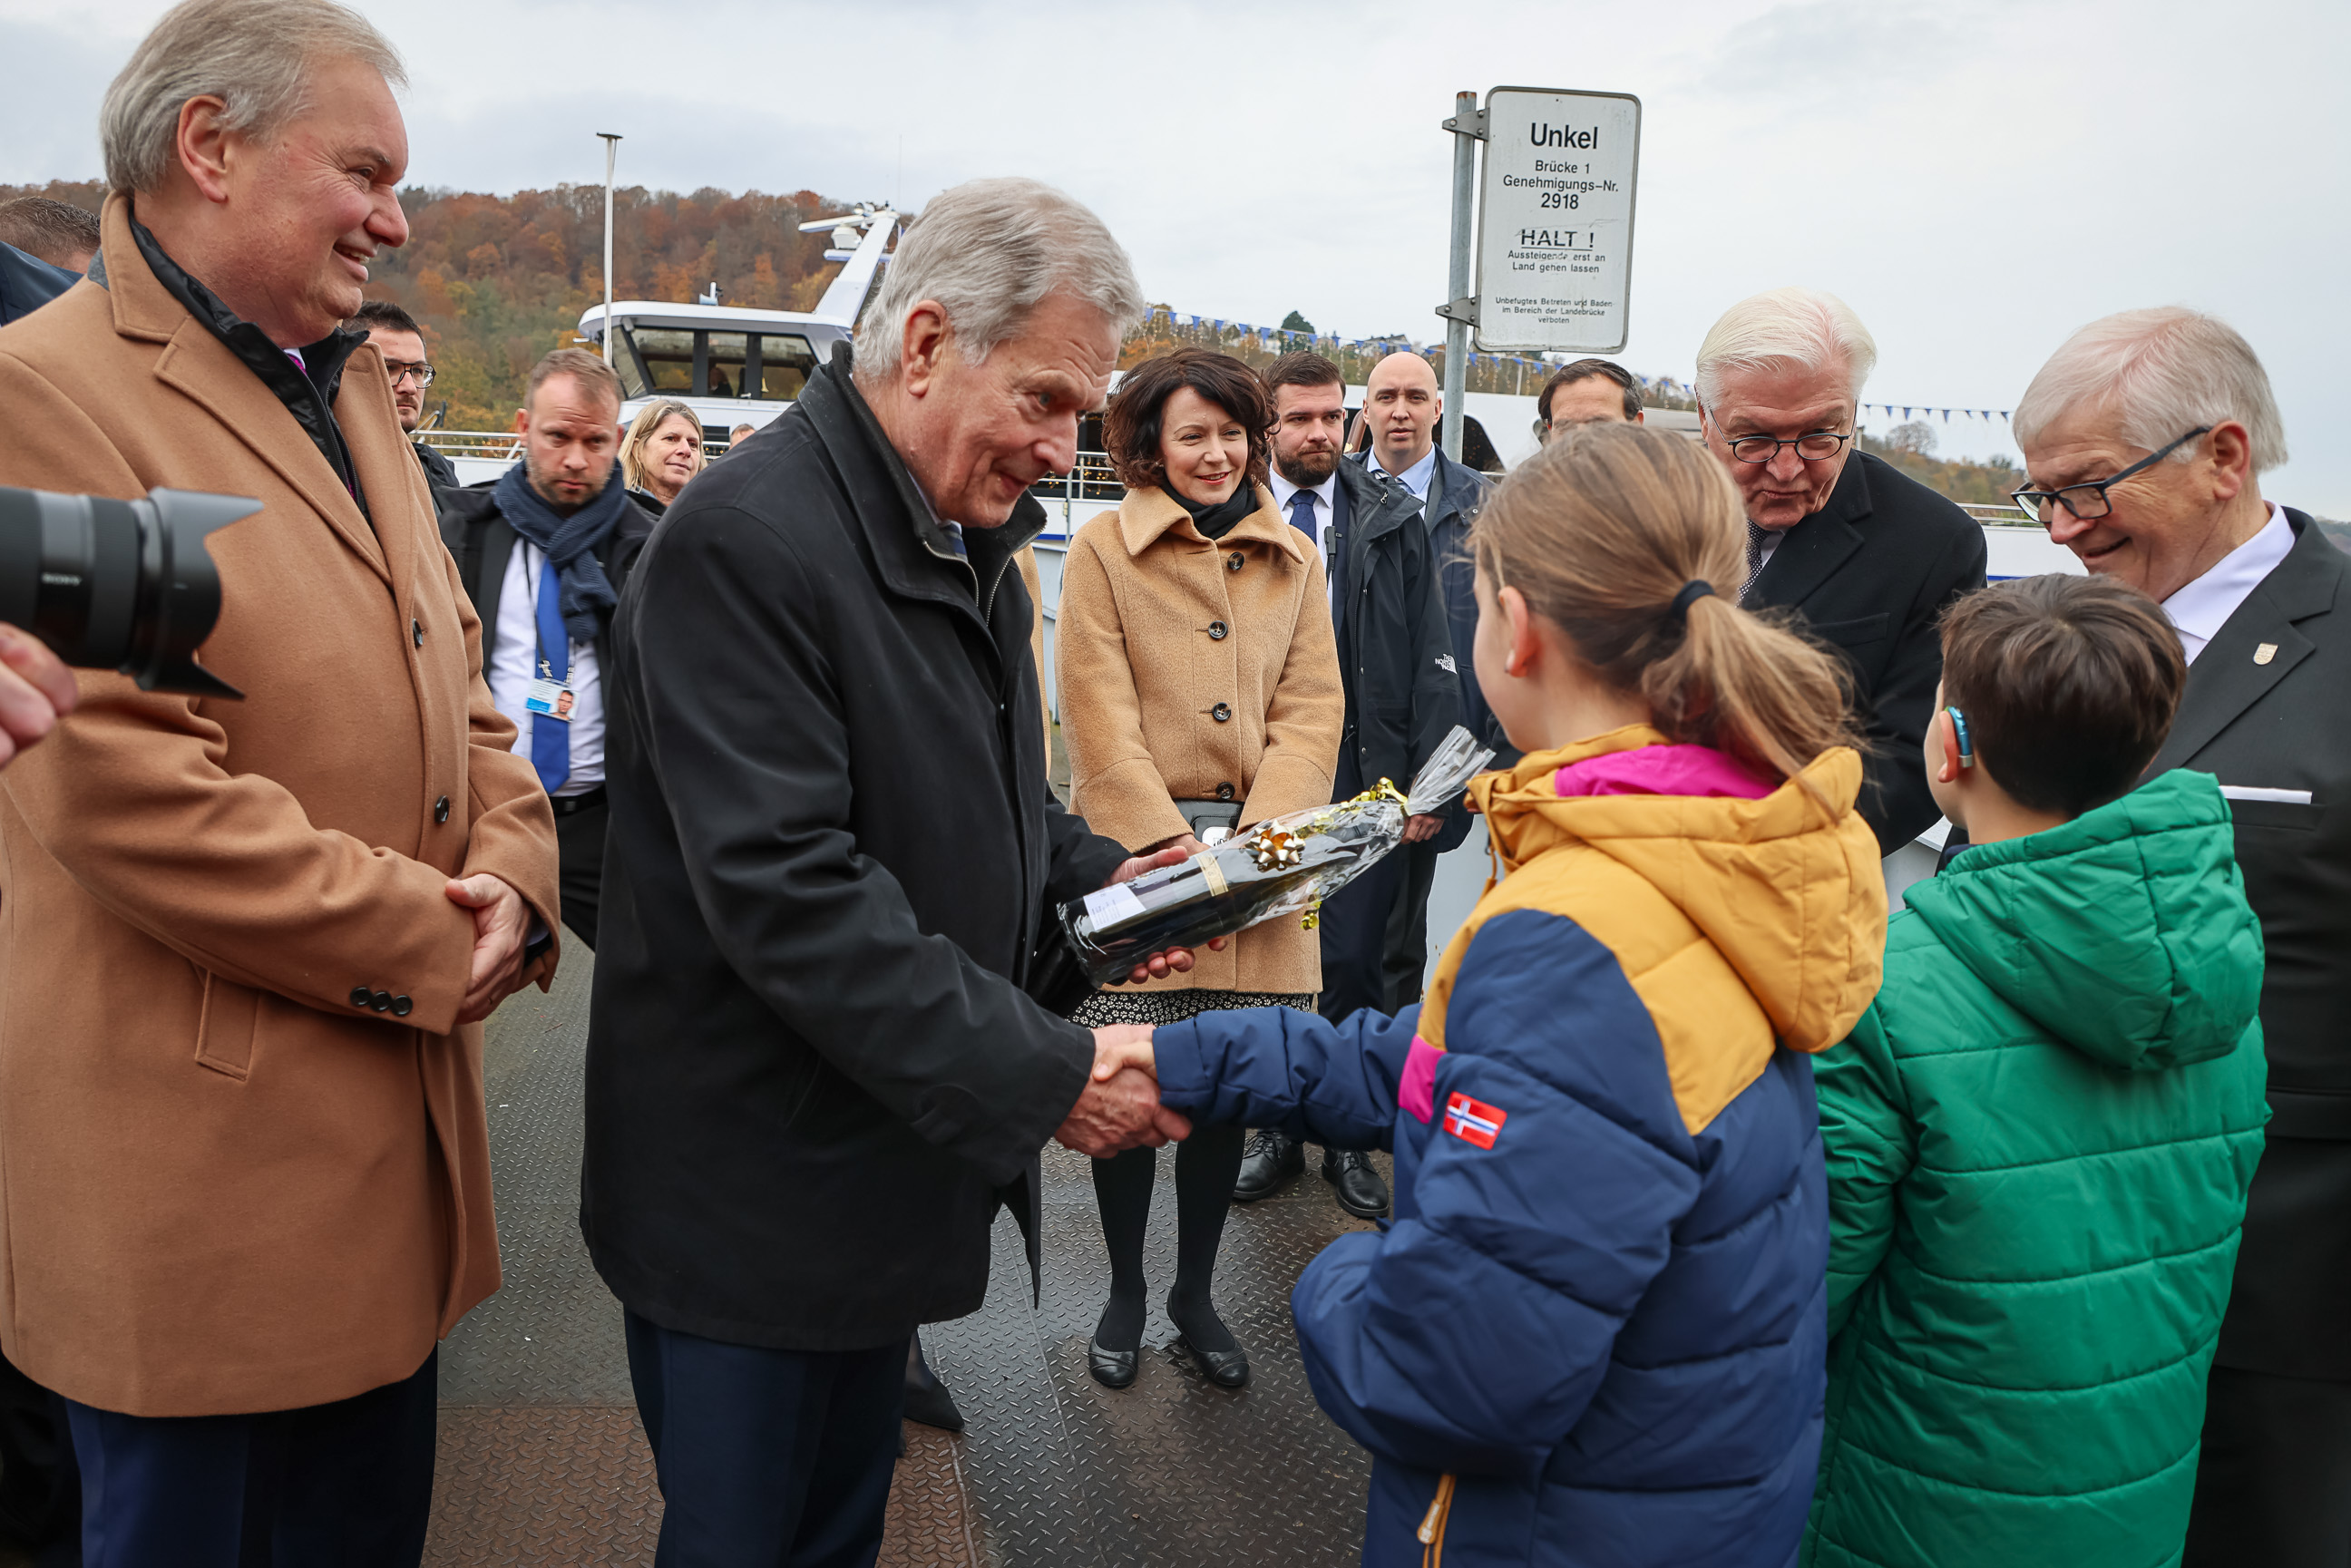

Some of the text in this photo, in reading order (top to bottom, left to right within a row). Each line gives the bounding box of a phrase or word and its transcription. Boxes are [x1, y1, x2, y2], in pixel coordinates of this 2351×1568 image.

[1530, 122, 1598, 150] Unkel
[1535, 160, 1590, 174] Brücke 1
[1503, 174, 1619, 193] Genehmigungs-Nr.
[1540, 192, 1579, 209] 2918
[1521, 229, 1595, 248] HALT !
[1573, 253, 1590, 261] erst
[1512, 261, 1599, 273] Land gehen lassen
[1495, 297, 1613, 307] Unbefugtes Betreten und Baden
[1560, 307, 1605, 317] Landebrücke
